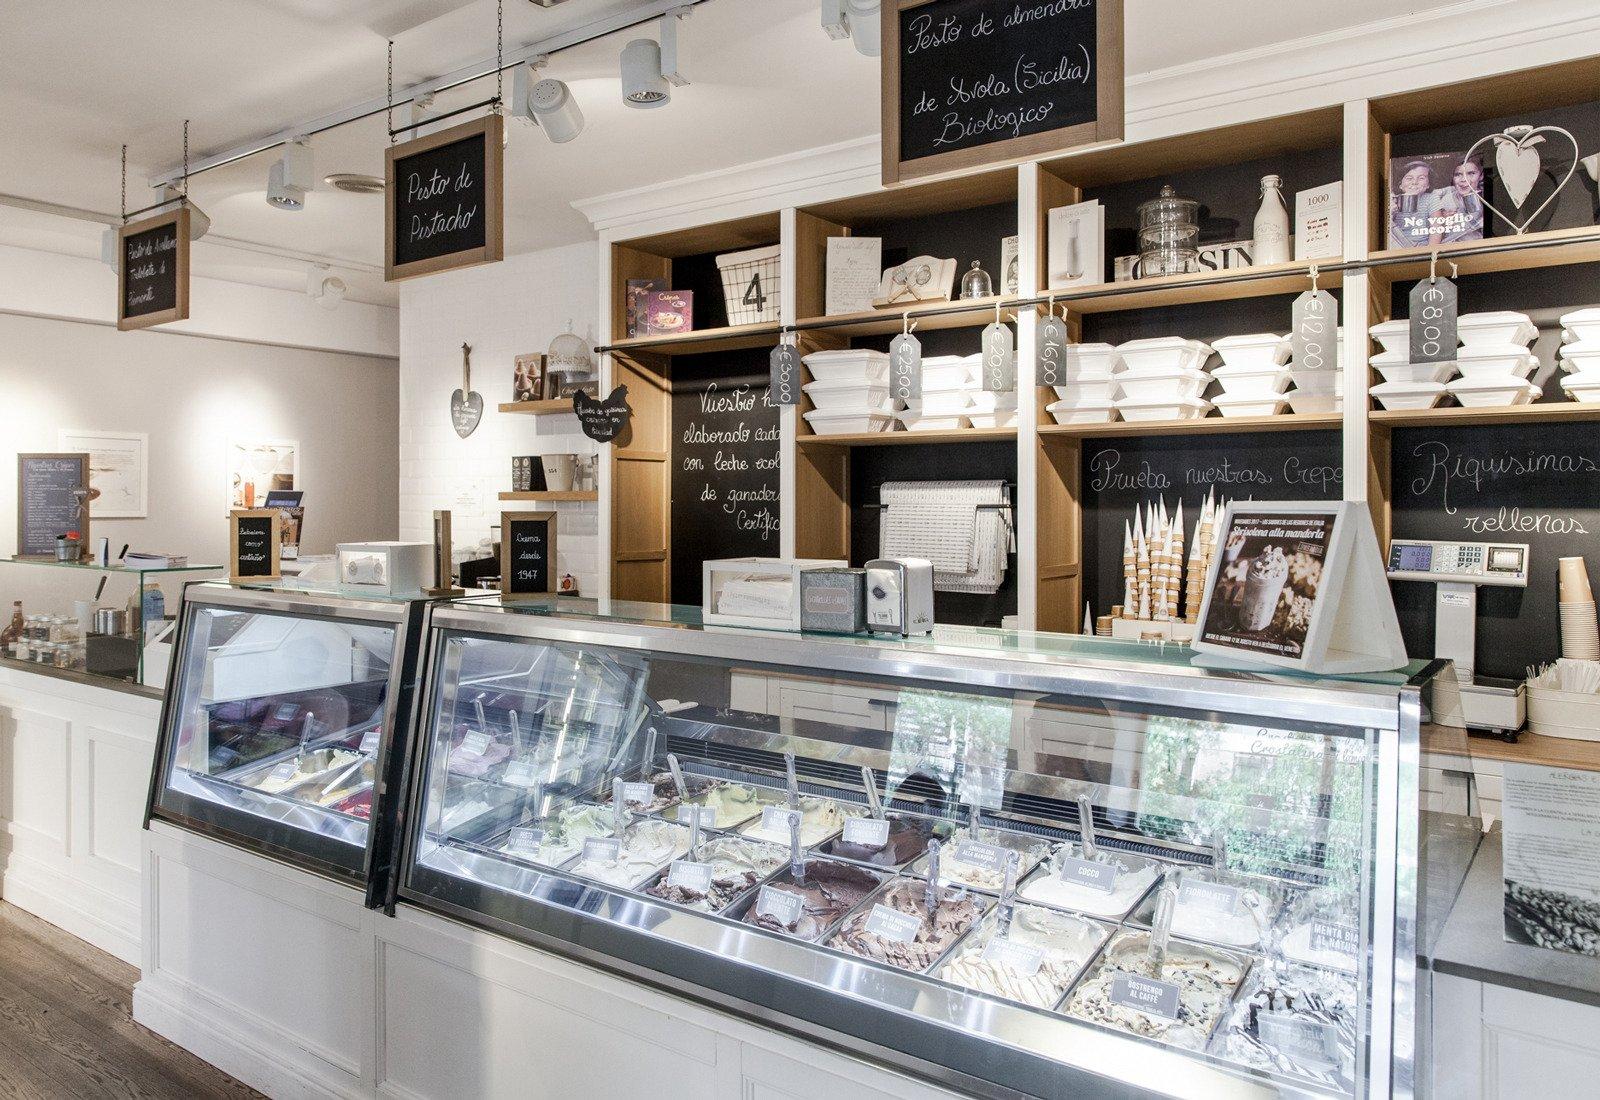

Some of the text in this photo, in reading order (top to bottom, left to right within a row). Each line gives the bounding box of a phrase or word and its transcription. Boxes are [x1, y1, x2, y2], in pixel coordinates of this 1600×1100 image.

[908, 14, 963, 54] Pesto
[971, 12, 994, 37] de
[913, 43, 1091, 116] de Avola (Sicilia)
[933, 101, 1053, 147] Biologico
[408, 162, 474, 203] Pesto de
[1307, 193, 1330, 207] 1000
[410, 203, 477, 244] Pistacho
[1403, 213, 1475, 227] Ne voglio
[1411, 222, 1466, 236] ancora!
[742, 273, 767, 312] 4
[683, 422, 750, 444] elaborado
[683, 457, 704, 471] con
[714, 450, 749, 471] leche
[1090, 448, 1171, 492] Prueba
[1185, 456, 1273, 485] nuestras
[700, 483, 717, 501] de
[1462, 506, 1590, 535] rellenas
[1269, 528, 1284, 537] alla
[1284, 529, 1324, 539] mandorla
[517, 569, 538, 580] 1947
[1078, 866, 1100, 879] COCCO
[1314, 924, 1342, 939] MENTA
[1130, 989, 1138, 999] AL
